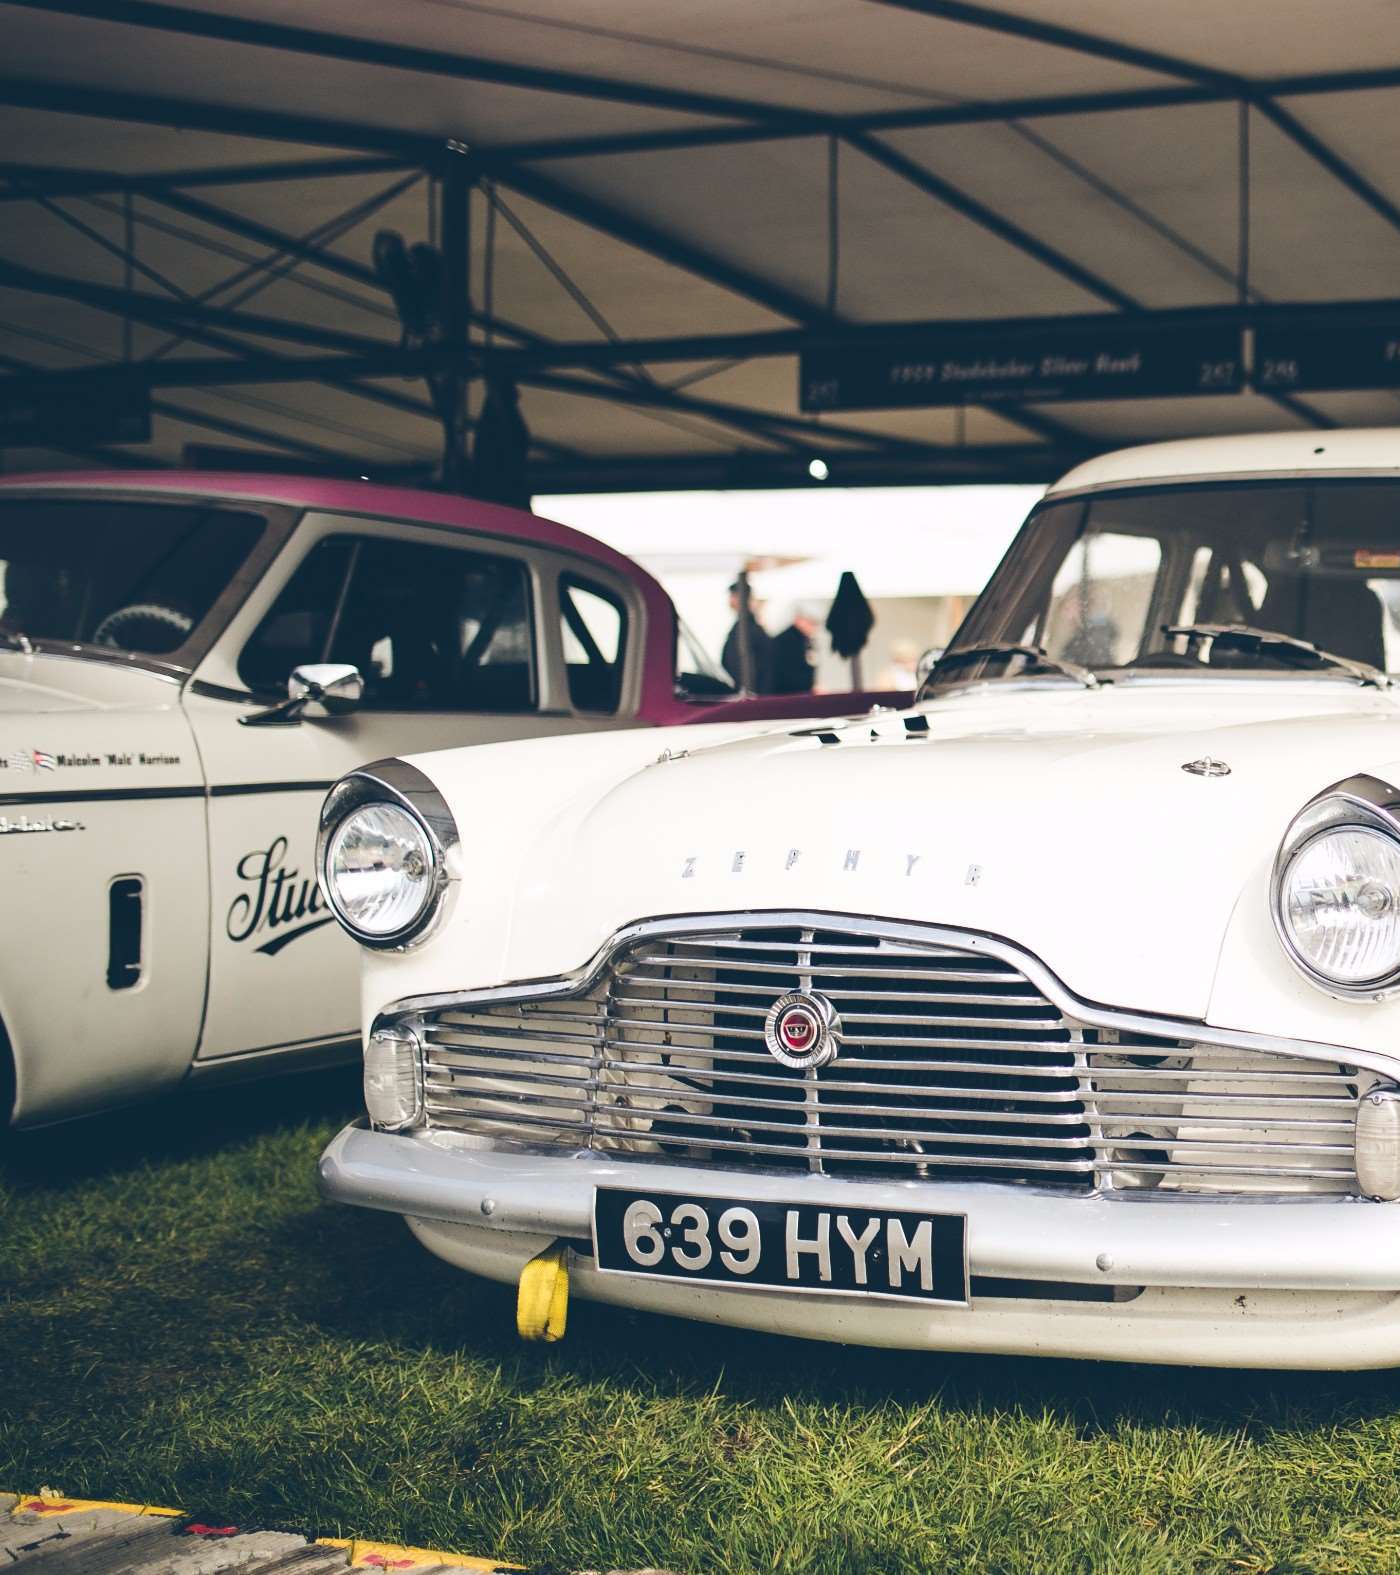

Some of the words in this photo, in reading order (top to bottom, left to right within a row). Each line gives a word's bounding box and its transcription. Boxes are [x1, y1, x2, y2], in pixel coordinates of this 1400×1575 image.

[56, 753, 101, 768] Malcolm
[681, 849, 983, 887] ZEPHYR
[623, 1199, 762, 1275] 639
[786, 1209, 934, 1292] HYM
